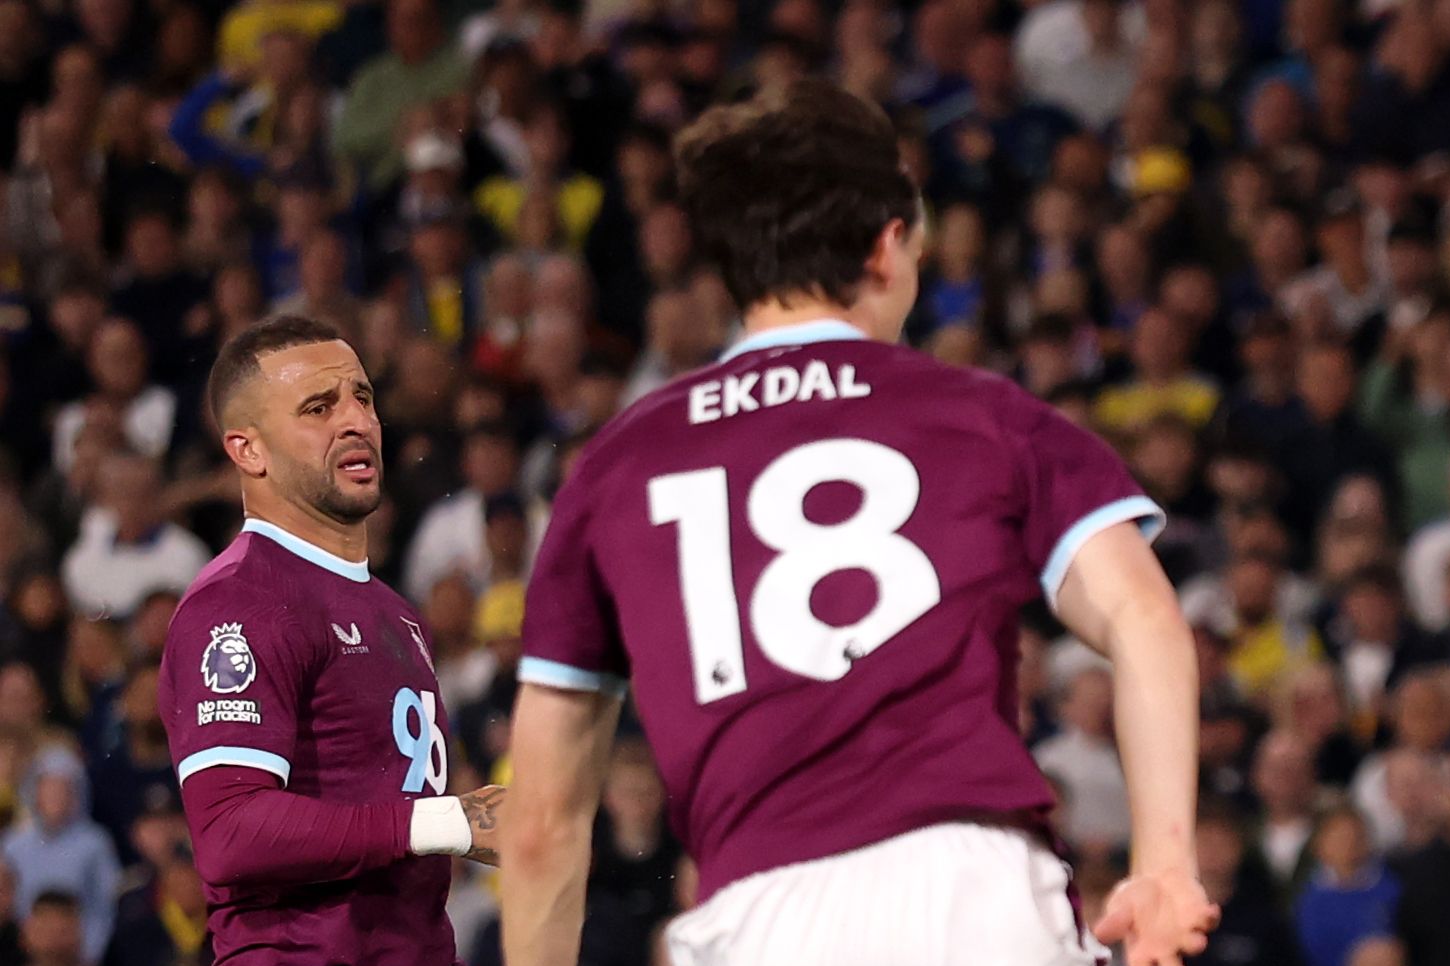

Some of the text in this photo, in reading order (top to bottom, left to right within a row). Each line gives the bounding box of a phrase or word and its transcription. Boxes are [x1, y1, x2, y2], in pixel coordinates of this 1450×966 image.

[689, 359, 871, 425] EKDAL
[648, 437, 941, 705] 18
[198, 700, 256, 712] No room
[198, 710, 261, 726] for racism
[392, 687, 448, 795] 96
